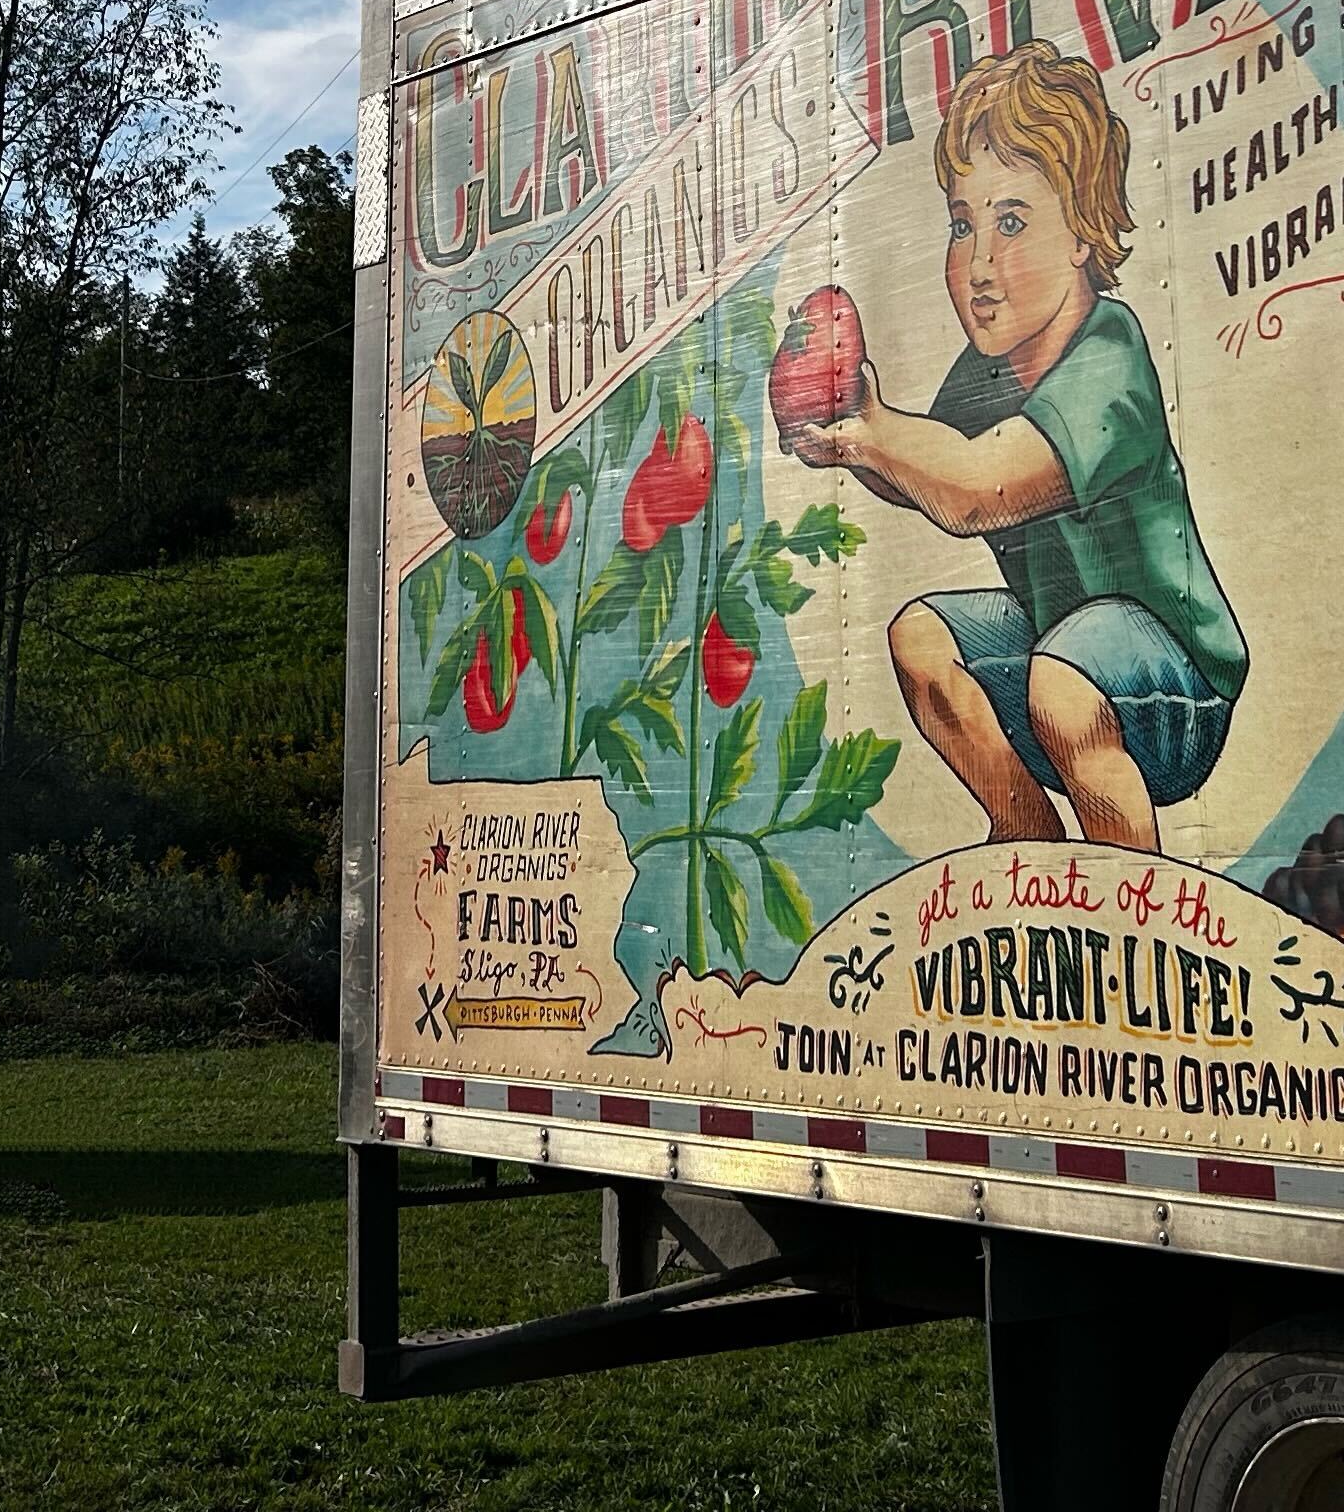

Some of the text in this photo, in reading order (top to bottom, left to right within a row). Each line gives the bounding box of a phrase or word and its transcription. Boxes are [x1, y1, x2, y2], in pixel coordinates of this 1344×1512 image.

[1173, 4, 1315, 133] LIVING
[547, 49, 800, 413] ORGANICS
[460, 811, 581, 851] CLARION RIVER
[477, 853, 569, 883] ORGANICS
[918, 852, 1238, 947] get a taste of the
[458, 890, 581, 949] FARMS
[529, 951, 565, 992] PA
[774, 1024, 851, 1075] JOIN
[863, 1041, 886, 1067] AT
[896, 1028, 1050, 1094] CLARION
[1059, 1045, 1164, 1107] RIVER
